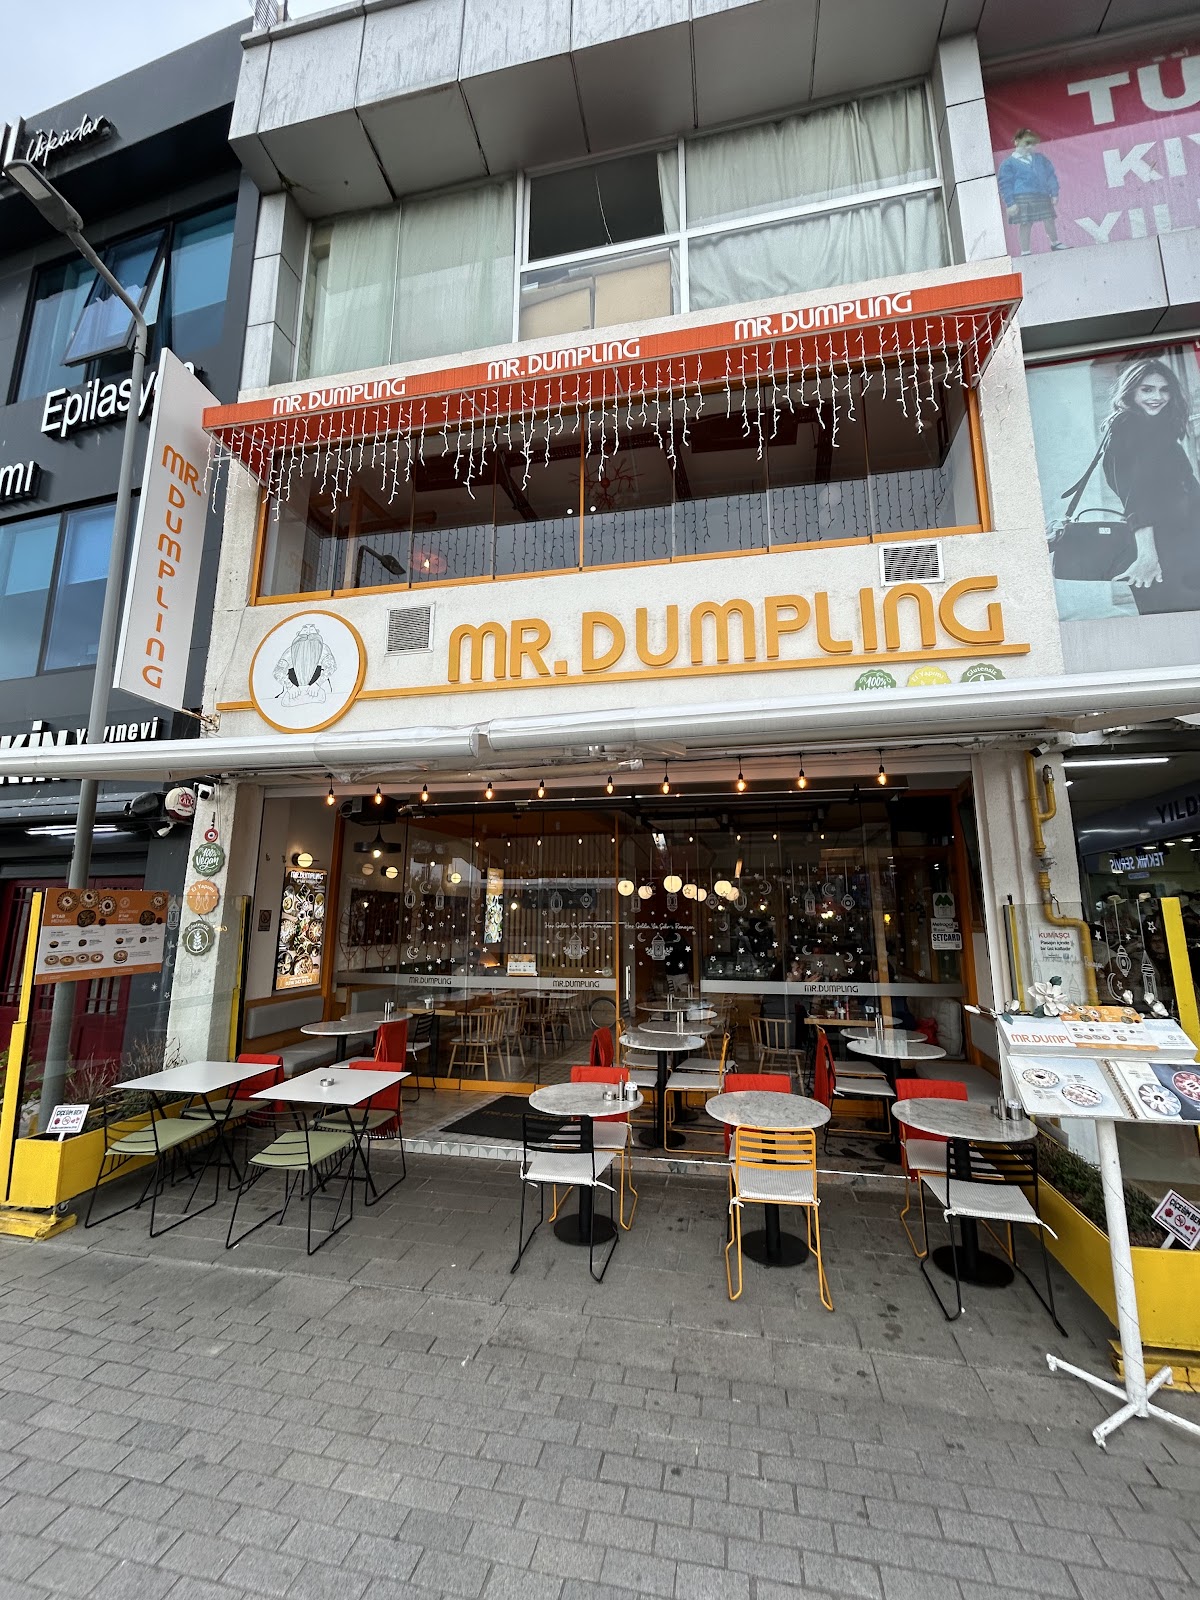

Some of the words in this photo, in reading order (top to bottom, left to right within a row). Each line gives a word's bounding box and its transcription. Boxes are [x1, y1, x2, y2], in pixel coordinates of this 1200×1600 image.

[1074, 198, 1200, 245] YIL
[966, 667, 998, 677] Glutensiz
[866, 676, 887, 687] 100%
[1156, 795, 1200, 824] YILD
[196, 855, 219, 870] Vegan
[932, 934, 961, 942] SETCARD
